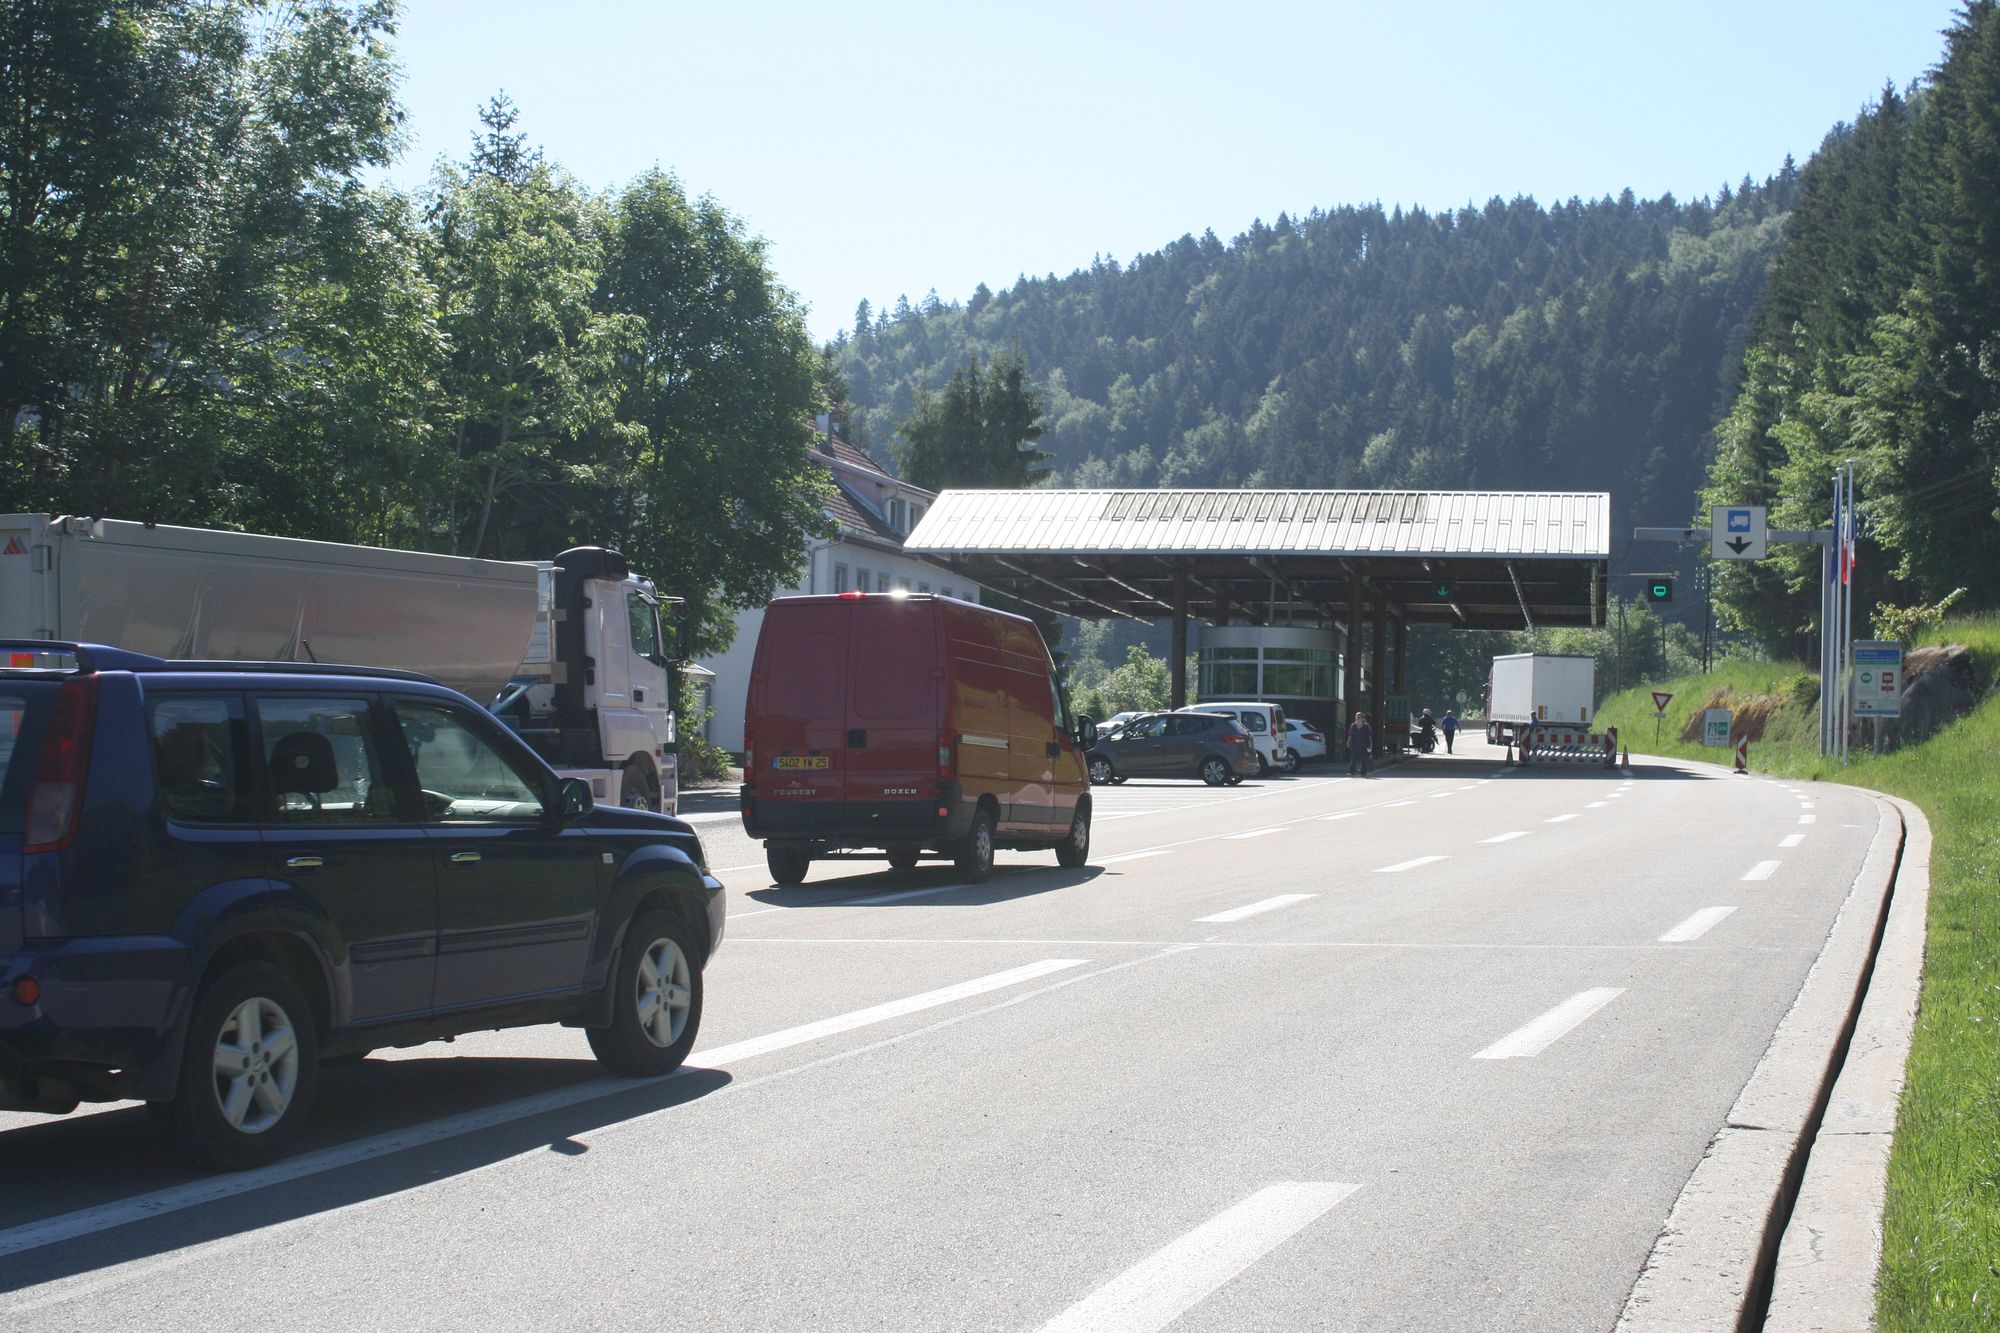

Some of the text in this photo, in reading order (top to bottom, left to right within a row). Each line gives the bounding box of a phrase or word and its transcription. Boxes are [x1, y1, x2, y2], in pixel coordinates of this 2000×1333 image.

[779, 757, 800, 768] 5402
[816, 757, 827, 768] 25
[773, 788, 817, 796] PEUGEOT
